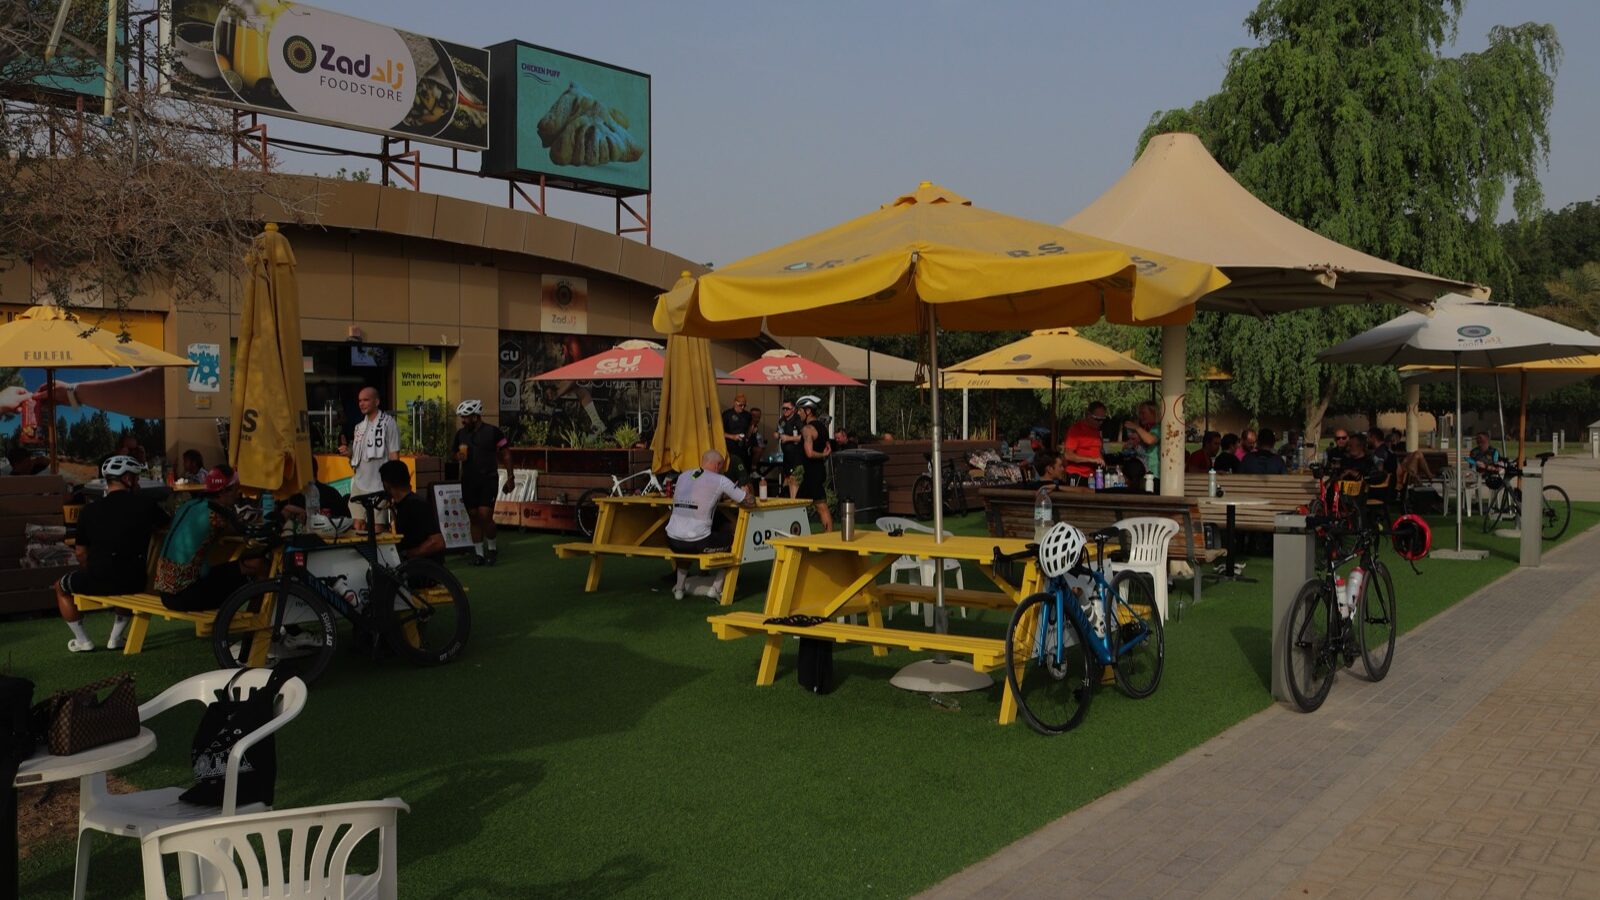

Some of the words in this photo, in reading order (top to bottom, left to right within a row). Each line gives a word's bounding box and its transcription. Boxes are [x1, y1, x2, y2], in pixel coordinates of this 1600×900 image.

[320, 44, 371, 78] Zad
[371, 59, 404, 90] زاد
[521, 63, 546, 75] CHICKEN
[546, 67, 561, 78] PUFF
[319, 75, 403, 102] FOODSTORE
[551, 313, 567, 325] Zad
[23, 350, 73, 361] FULFIL
[500, 349, 520, 361] GU
[596, 354, 642, 370] GU
[401, 370, 421, 379] When
[422, 372, 442, 380] water
[762, 362, 802, 377] GU
[416, 380, 442, 389] enough
